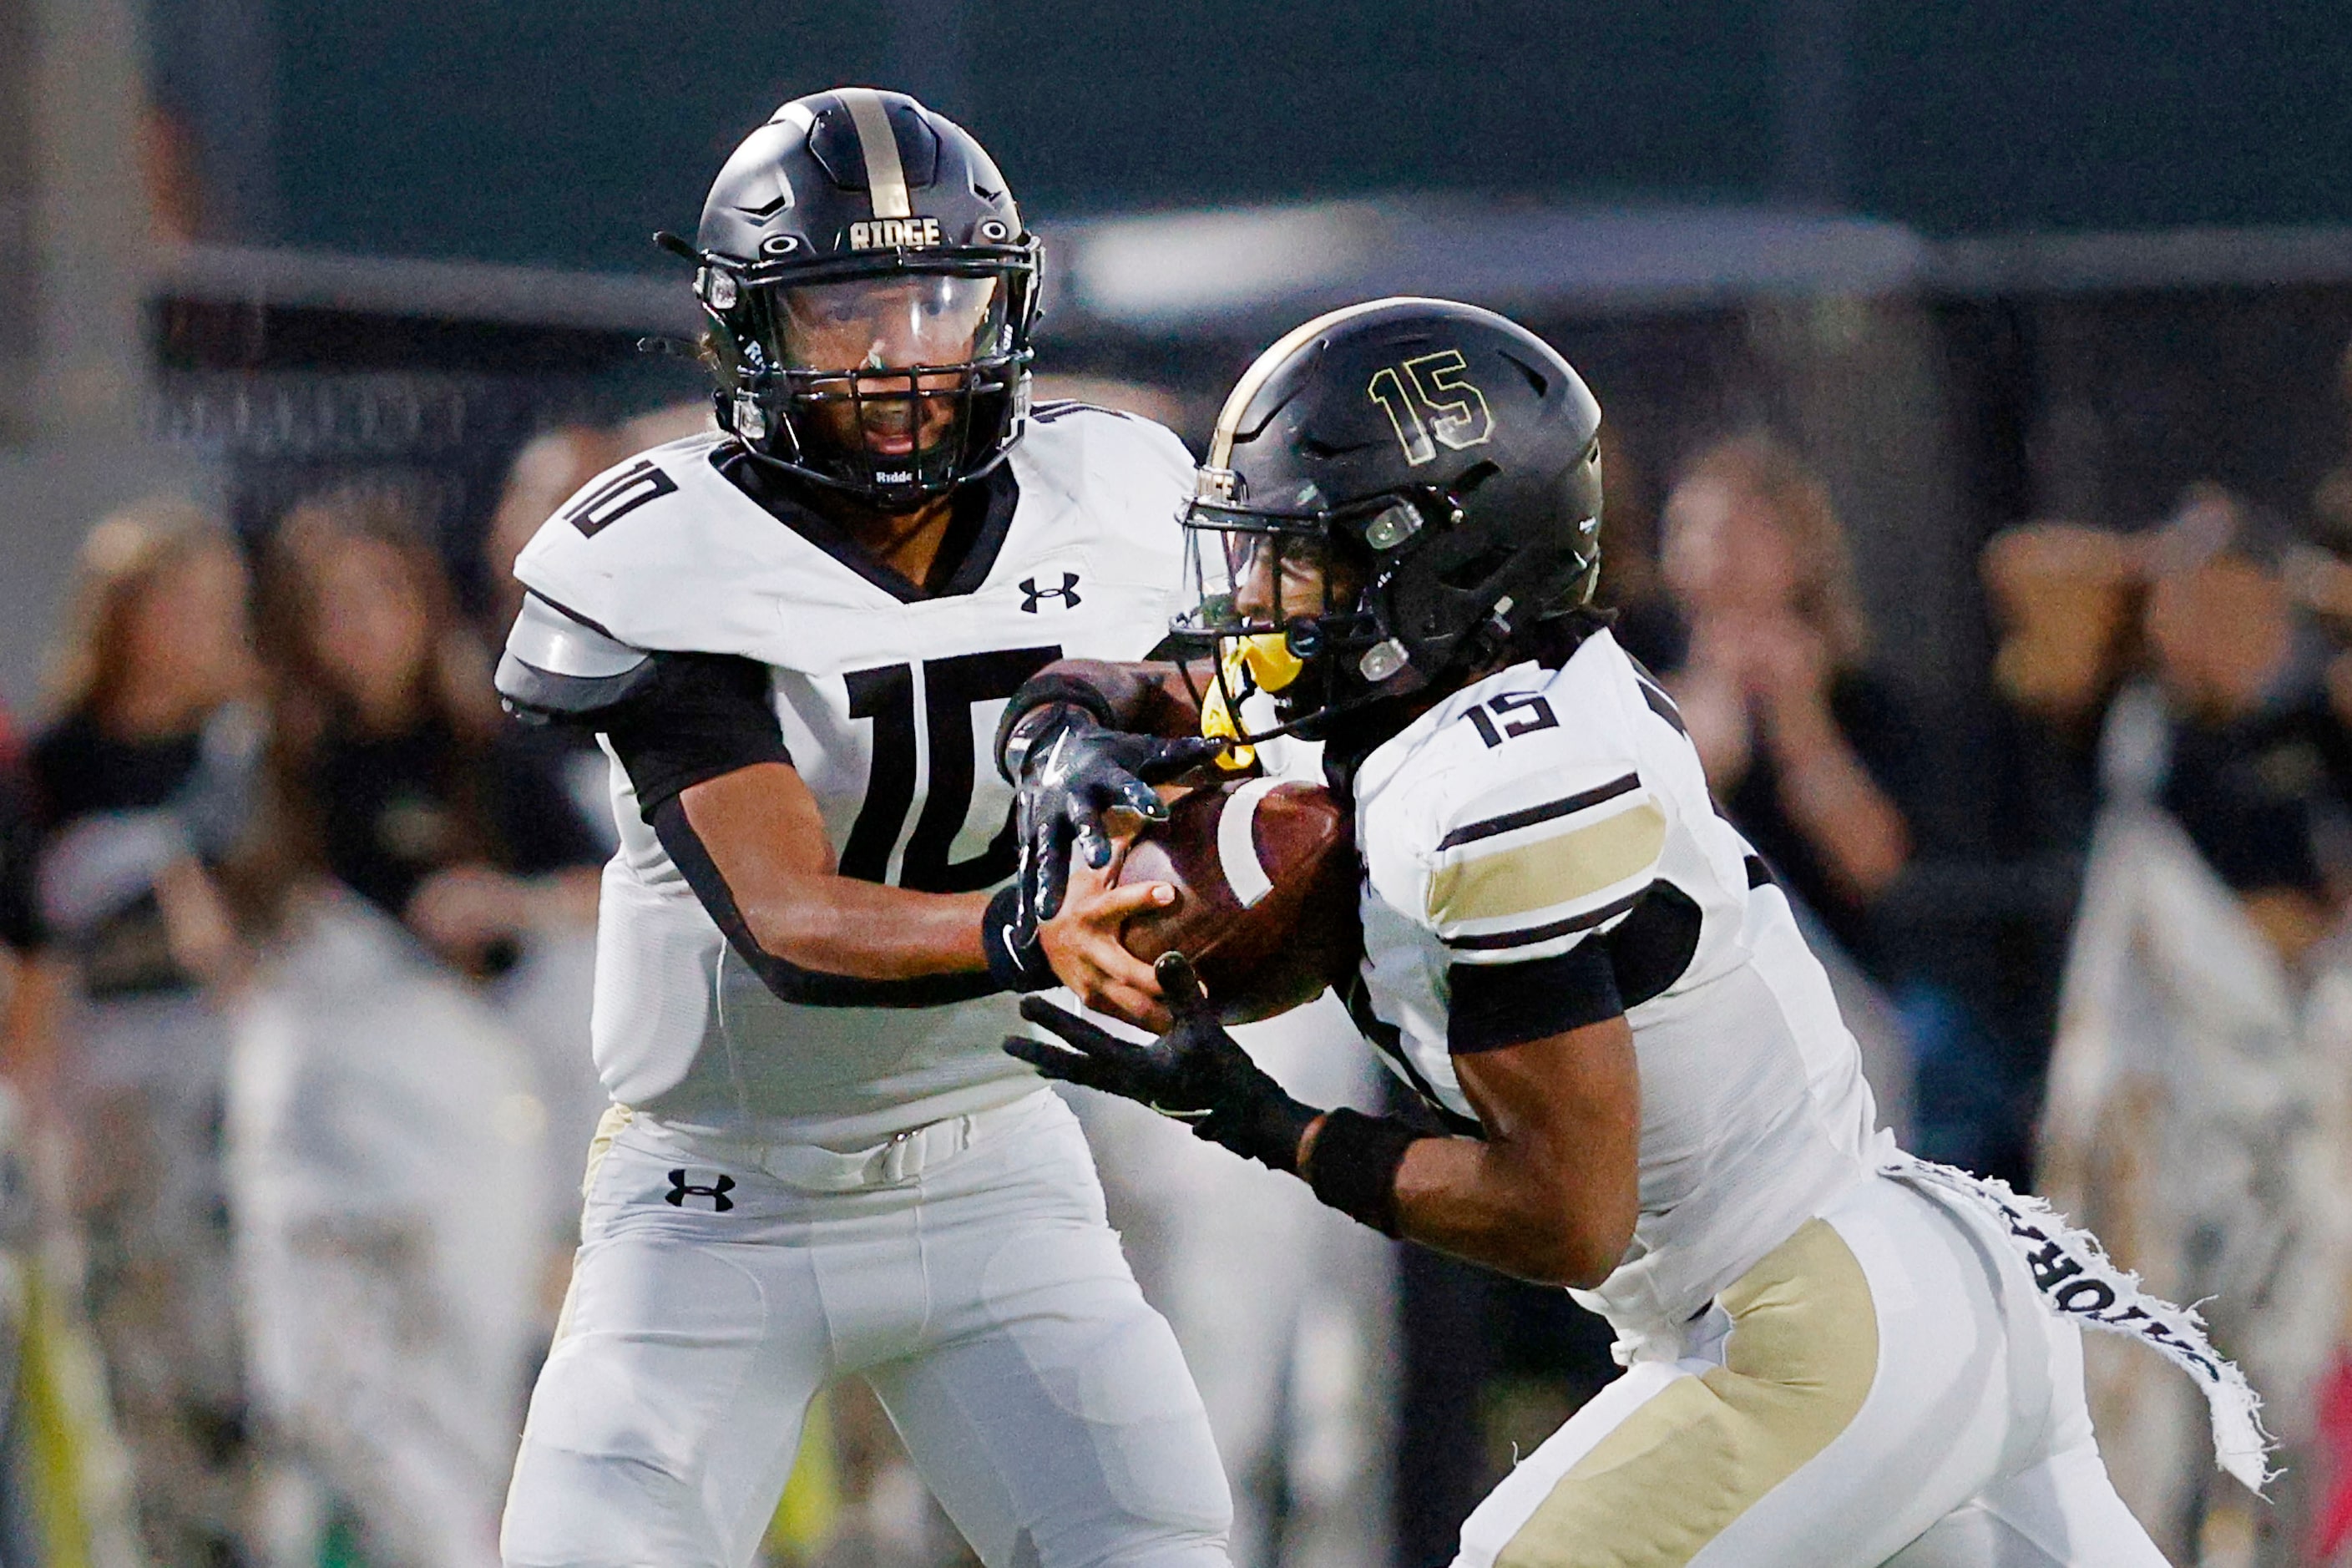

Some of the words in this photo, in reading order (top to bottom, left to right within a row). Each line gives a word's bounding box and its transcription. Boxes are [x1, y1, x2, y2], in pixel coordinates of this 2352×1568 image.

[850, 218, 940, 250] RIDGE
[1368, 349, 1495, 467] 15
[563, 459, 679, 539] 10
[1457, 690, 1560, 749] 15
[837, 645, 1064, 893] 10
